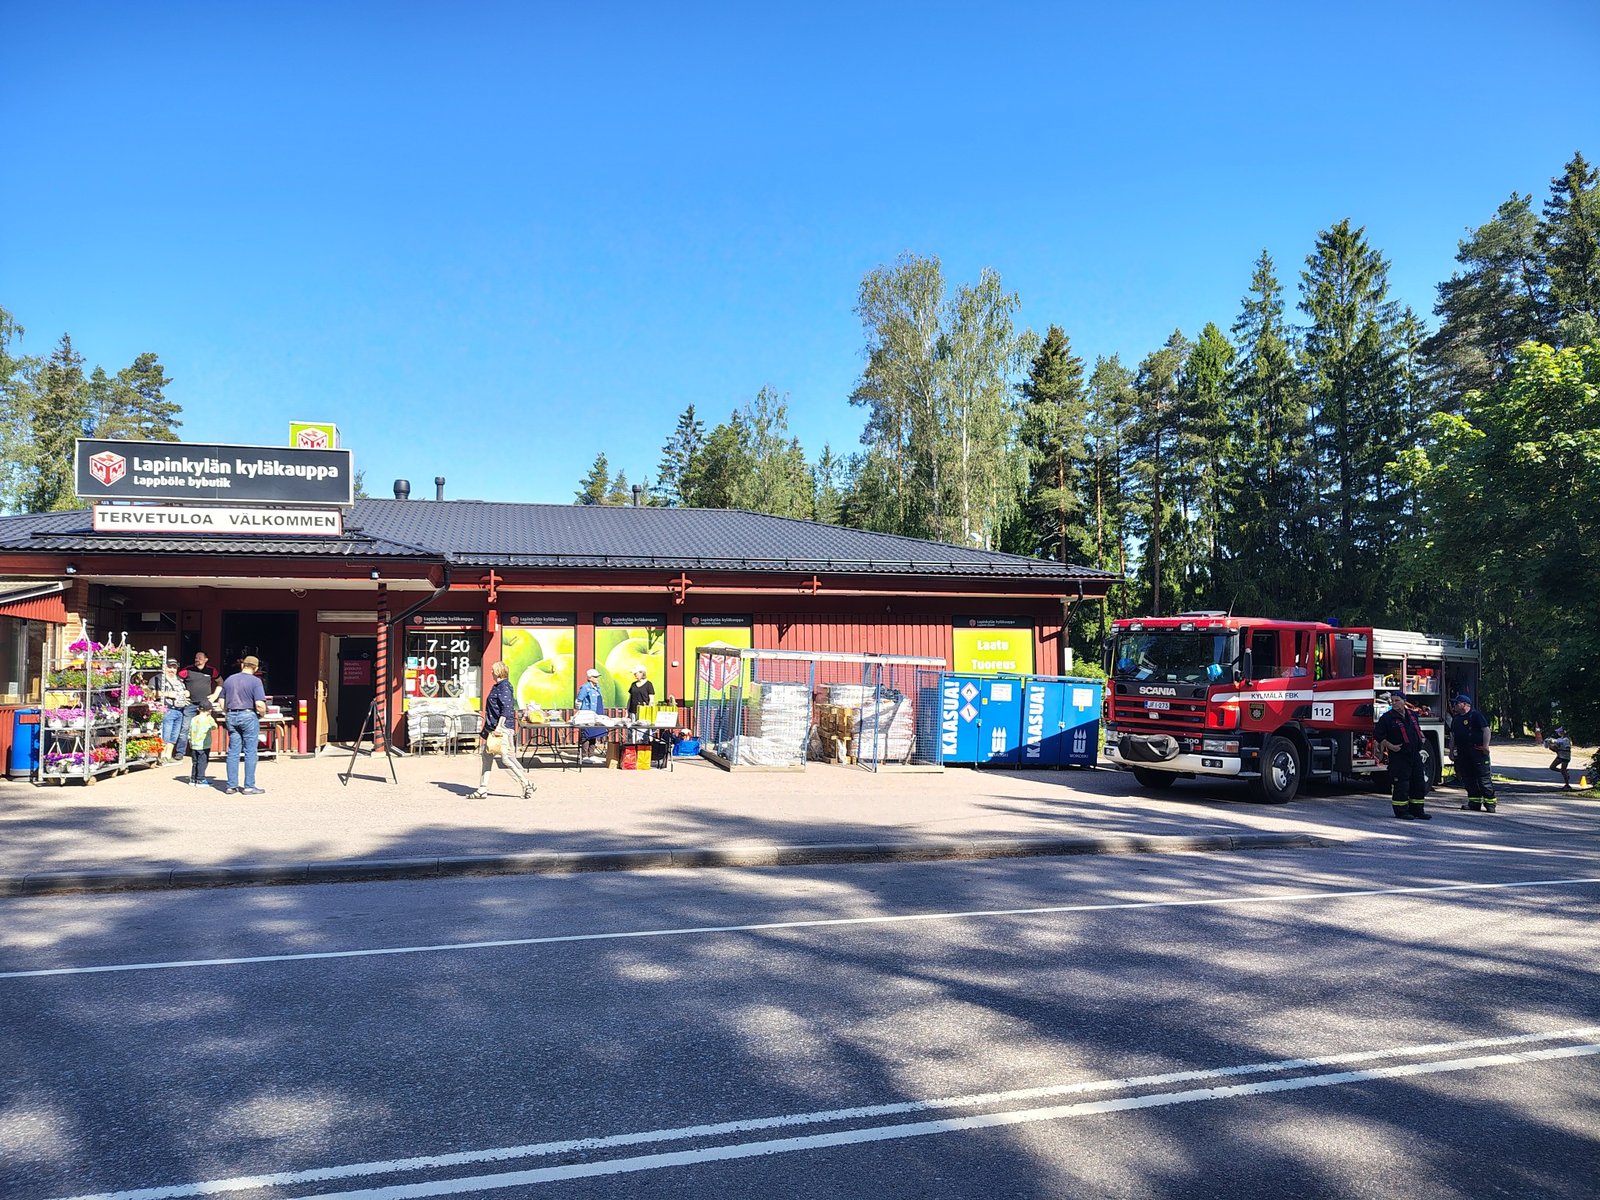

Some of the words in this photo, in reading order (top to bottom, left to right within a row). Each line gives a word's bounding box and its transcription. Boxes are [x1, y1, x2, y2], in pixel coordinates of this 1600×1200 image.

[133, 456, 231, 477] Lapinkylän
[235, 458, 339, 481] kyläkauppa
[133, 475, 186, 488] Lappböle
[187, 476, 231, 489] bybutik
[98, 511, 214, 525] TERVETULOA
[229, 513, 336, 527] VÄLKOMMEN
[427, 639, 438, 653] 7
[450, 639, 471, 653] 20
[976, 639, 1009, 651] Laatu
[418, 656, 438, 670] 10
[451, 656, 470, 670] 18
[970, 658, 1017, 671] Tuoreus
[418, 673, 438, 687] 10
[1139, 686, 1177, 696] SCANIA
[942, 681, 960, 755] KAASUA!
[1313, 707, 1332, 717] 112
[1026, 686, 1046, 758] KAASUA!
